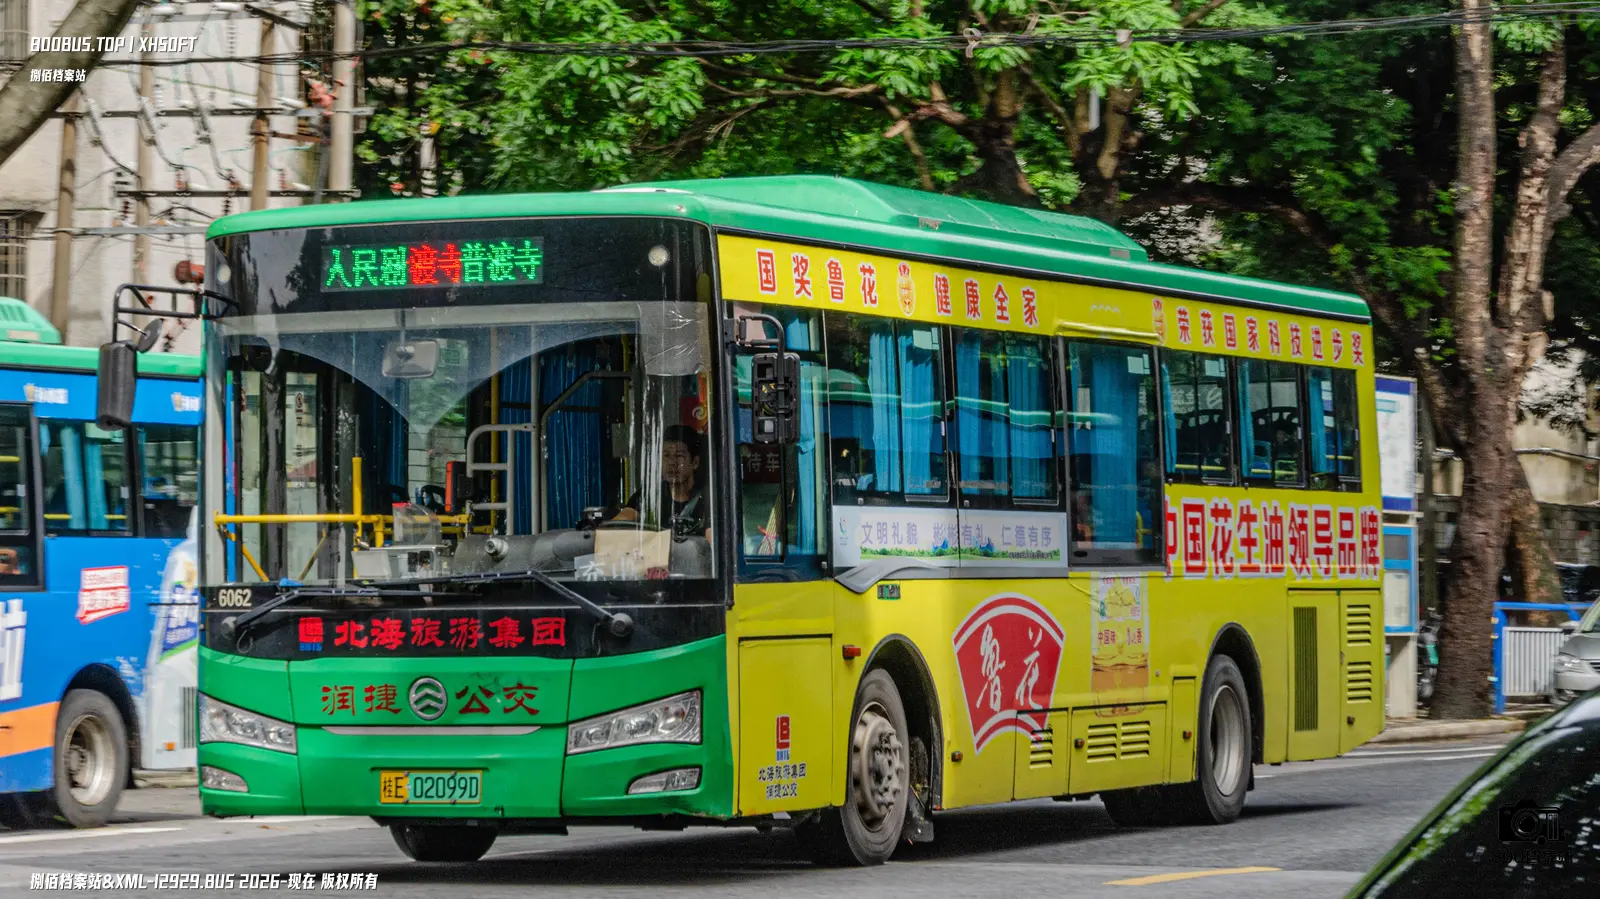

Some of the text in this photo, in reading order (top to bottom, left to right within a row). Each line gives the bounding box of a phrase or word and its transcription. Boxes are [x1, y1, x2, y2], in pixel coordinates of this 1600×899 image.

[756, 249, 1039, 328] 国奖鲁花 健康全家
[1176, 306, 1365, 366] 荣获国家科技进步奖
[861, 522, 918, 545] 文明礼貌
[1001, 525, 1053, 548] 仁德有序
[218, 588, 252, 608] 6062
[333, 617, 567, 650] 北海旅游集团
